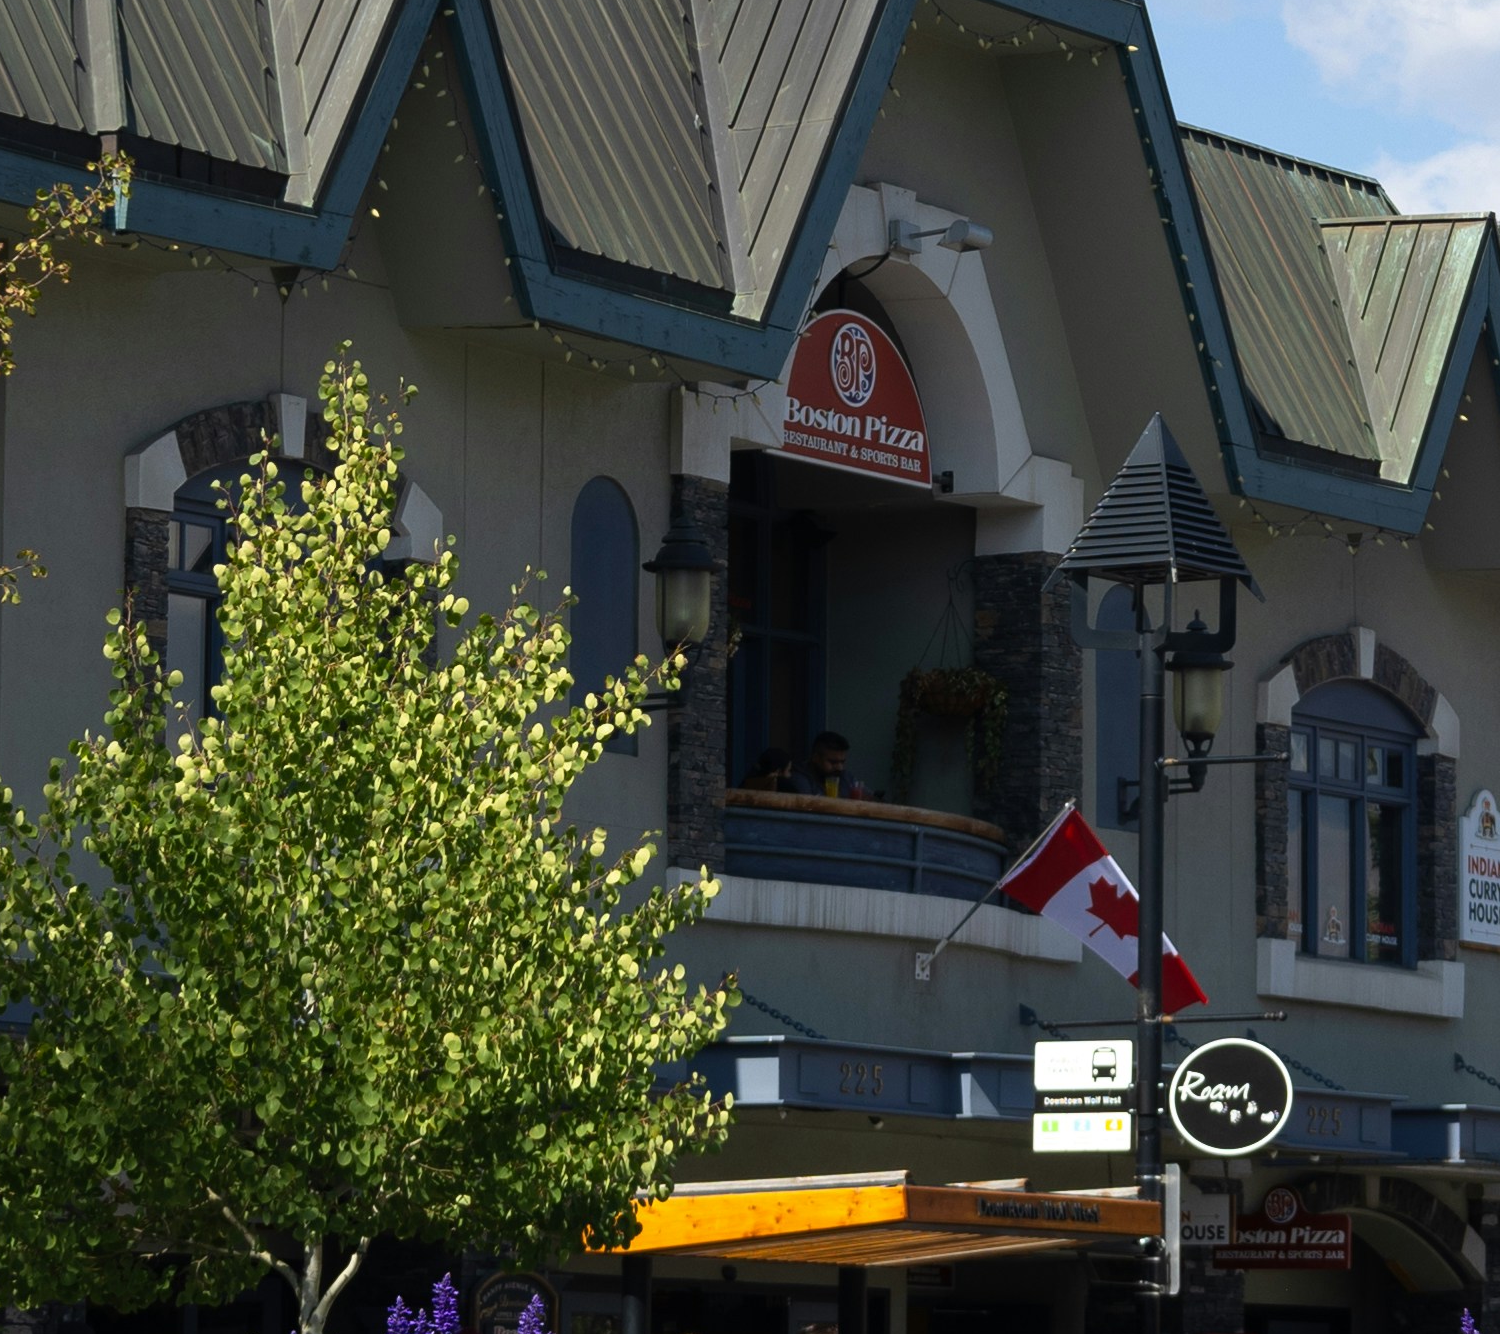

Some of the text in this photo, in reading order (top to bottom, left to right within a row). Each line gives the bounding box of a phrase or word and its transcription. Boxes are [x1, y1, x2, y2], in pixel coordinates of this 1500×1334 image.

[785, 396, 924, 453] Boston Pizza
[784, 429, 922, 473] RESTAURANT & SPORTS BAR
[840, 1061, 884, 1096] 225
[1178, 1070, 1251, 1101] Roam
[1043, 1095, 1122, 1106] Downtown Wolf West
[1307, 1105, 1341, 1136] 225
[1181, 1225, 1226, 1241] OUSE
[1235, 1226, 1346, 1245] oston Pizza
[1215, 1249, 1276, 1260] RESTAURANT
[1287, 1249, 1323, 1260] SPORTS
[1324, 1250, 1346, 1260] BAR
